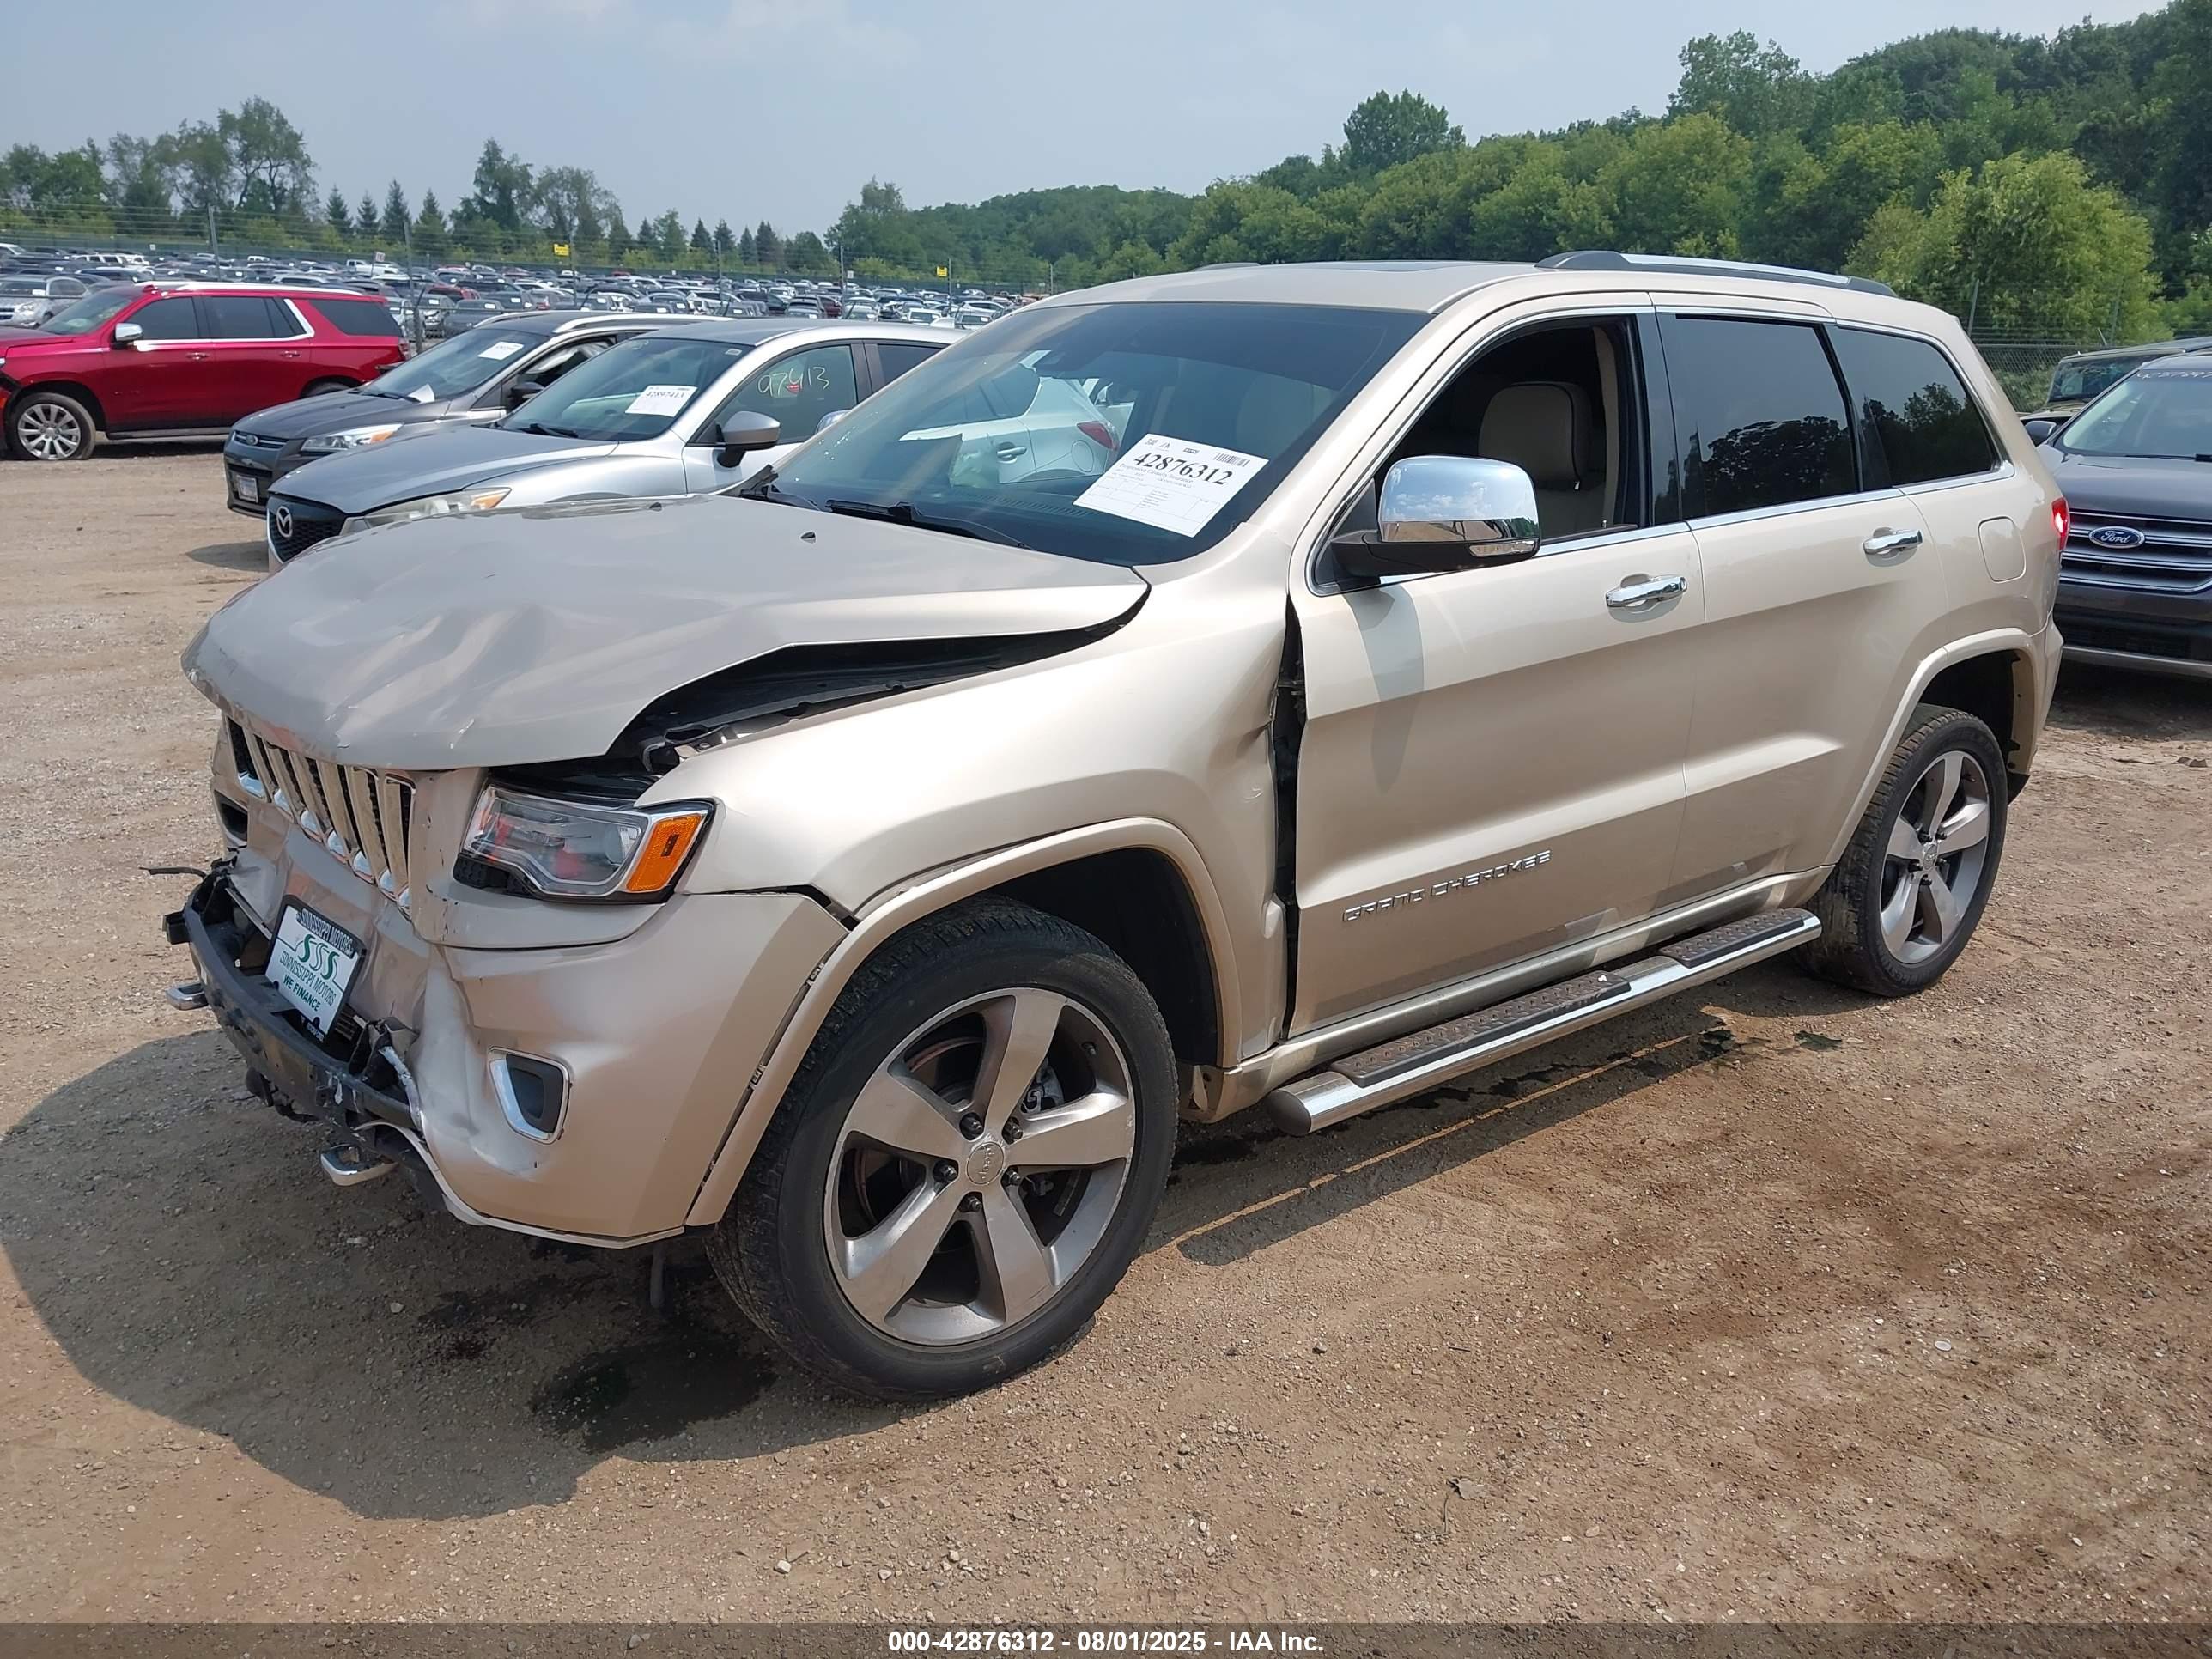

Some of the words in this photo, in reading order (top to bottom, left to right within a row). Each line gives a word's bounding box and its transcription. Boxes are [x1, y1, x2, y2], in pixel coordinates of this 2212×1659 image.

[757, 367, 830, 397] 97413
[1133, 452, 1233, 485] 42876312
[1342, 888, 1425, 921] GRAND
[1431, 849, 1551, 896] CHEROKEE
[283, 975, 294, 988] WE
[293, 986, 322, 1012] FINANCE
[314, 977, 337, 1006] MOTORS
